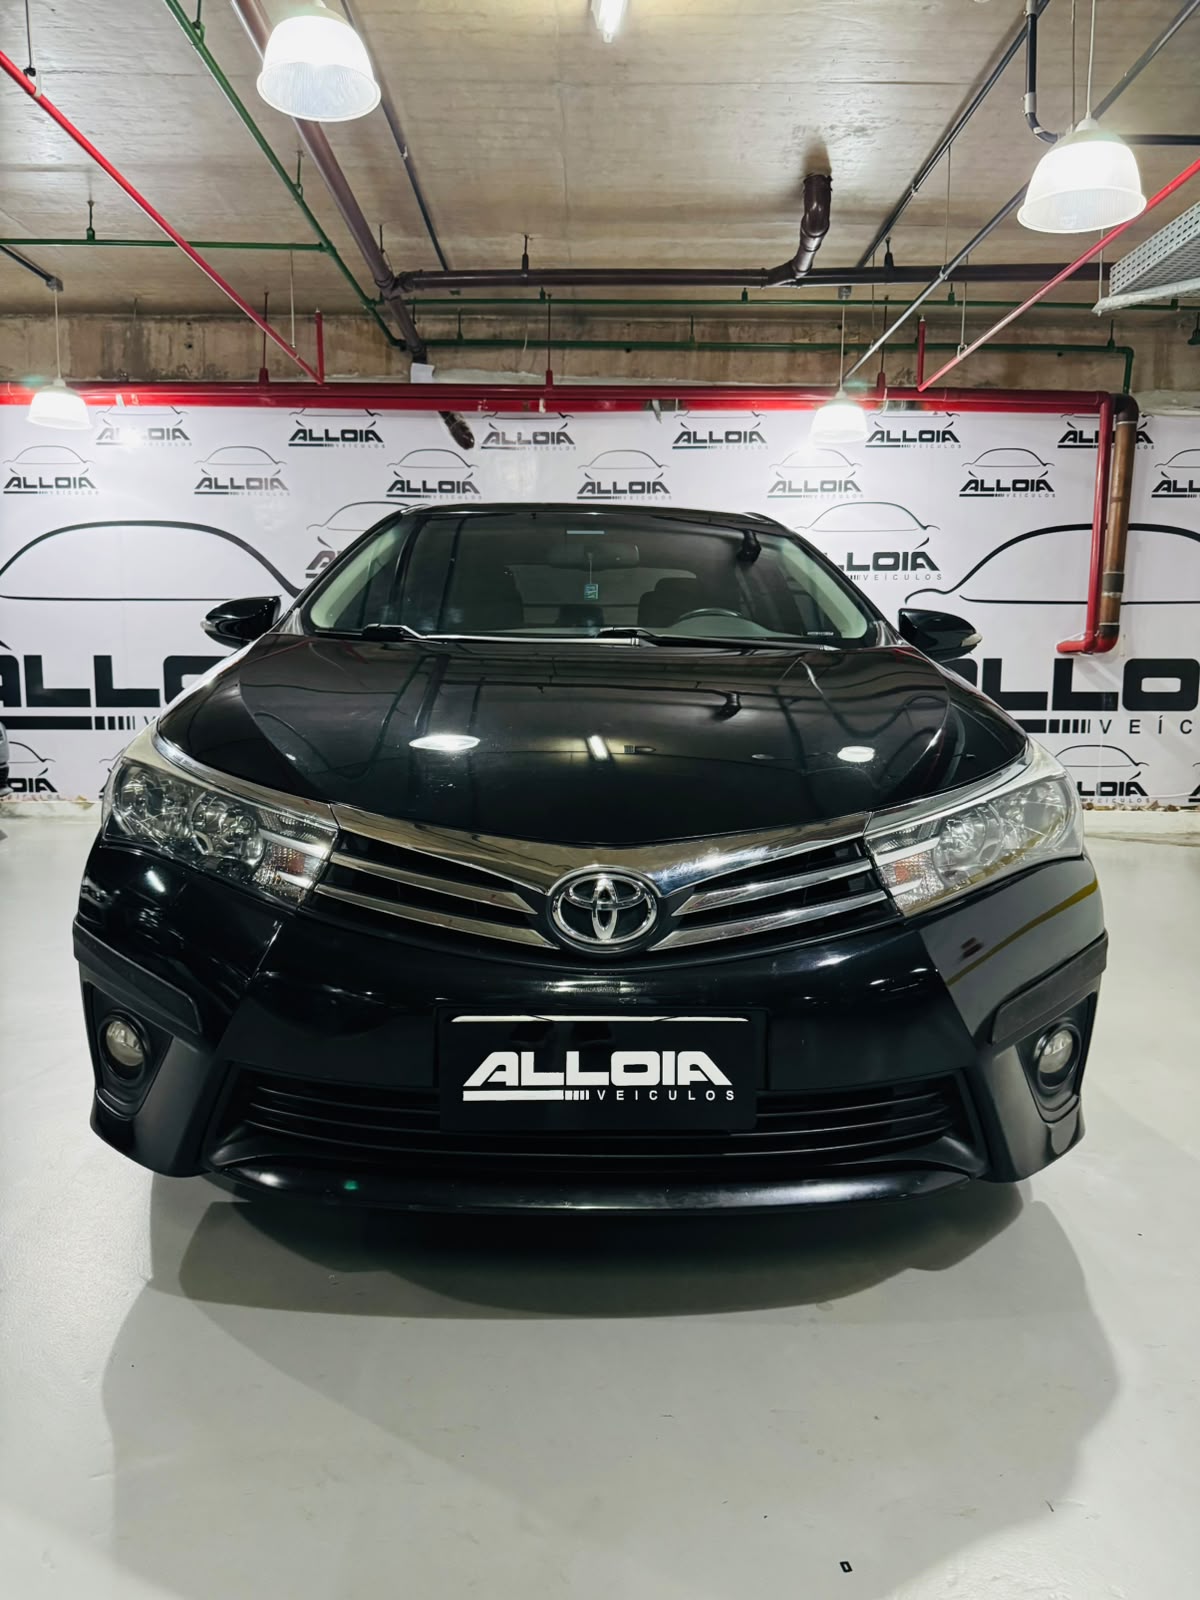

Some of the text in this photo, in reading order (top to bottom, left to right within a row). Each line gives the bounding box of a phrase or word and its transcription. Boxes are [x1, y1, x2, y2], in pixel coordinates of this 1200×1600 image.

[289, 429, 384, 443] ALLOIA
[482, 432, 575, 445] ALLOIA
[673, 431, 767, 444] ALLOIA
[866, 430, 960, 443] ALLOIA
[3, 477, 97, 489] ALLOIA
[194, 477, 289, 491] ALLOIA
[387, 480, 480, 494] ALLOIA
[577, 481, 670, 494] ALLOIA
[768, 480, 861, 493] ALLOIA
[960, 479, 1054, 492] ALLOIA
[1099, 715, 1193, 734] VEÍC
[463, 1051, 732, 1086] ALLOIA
[597, 1089, 735, 1100] VEICULOS
